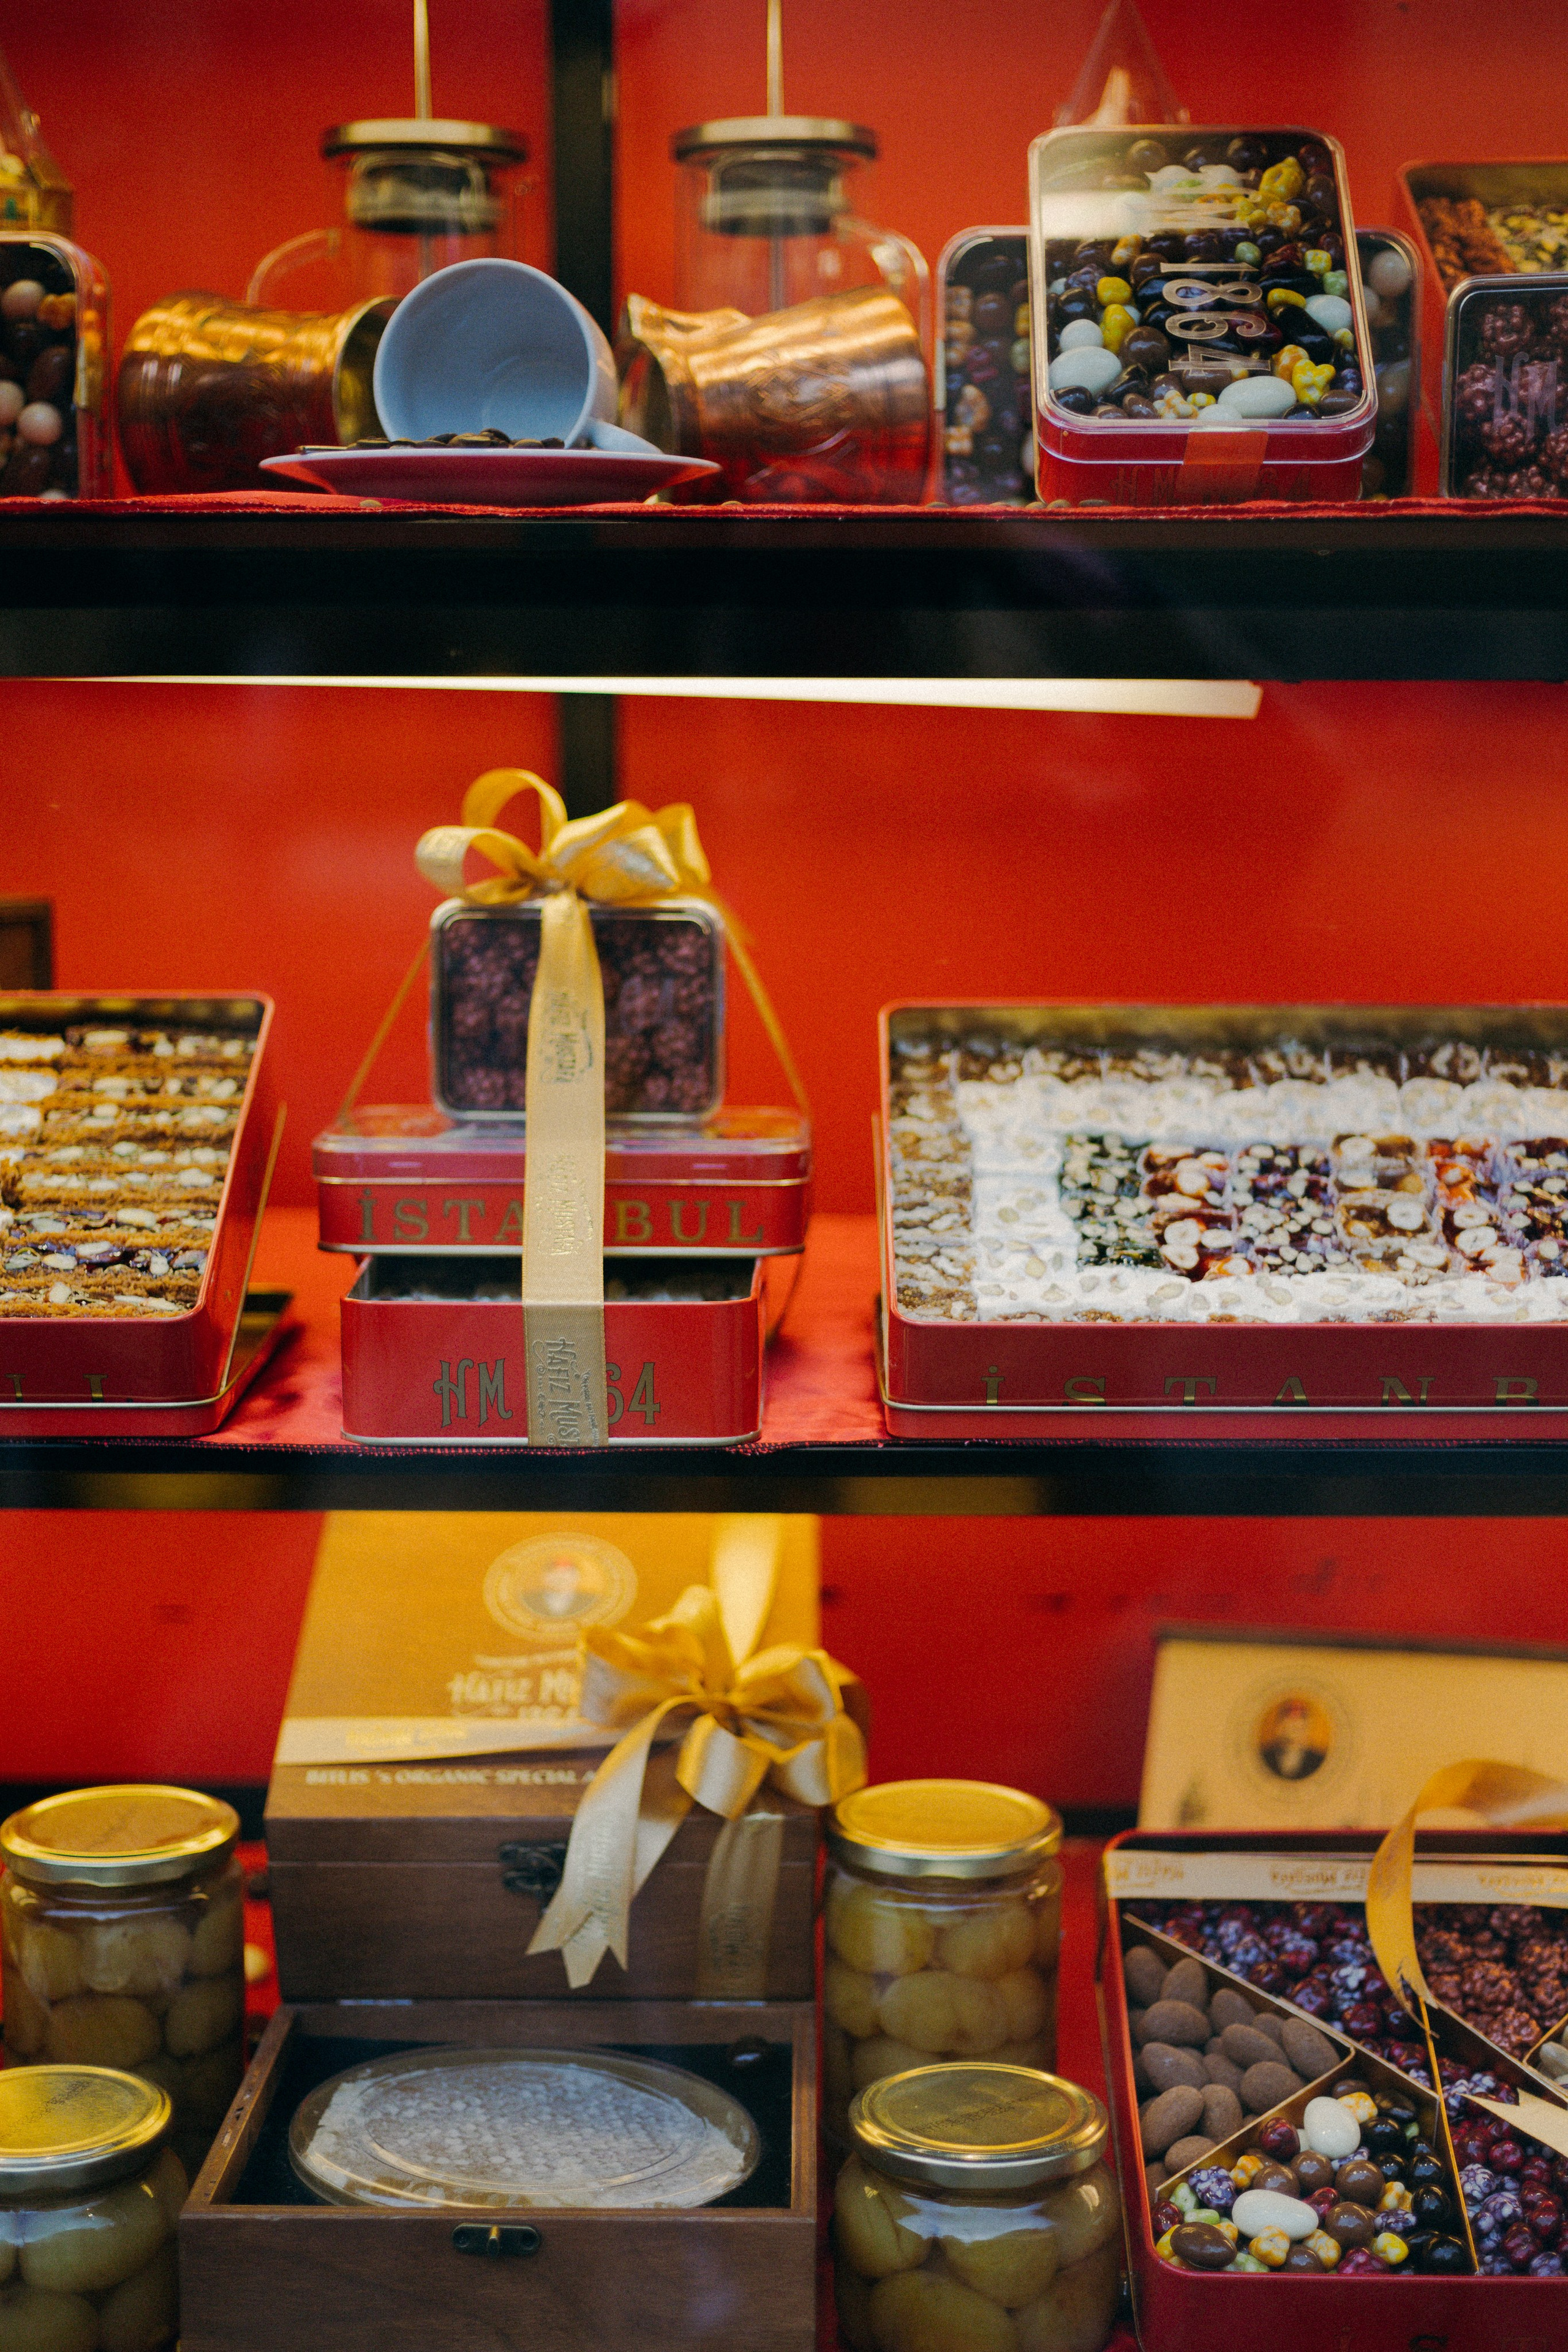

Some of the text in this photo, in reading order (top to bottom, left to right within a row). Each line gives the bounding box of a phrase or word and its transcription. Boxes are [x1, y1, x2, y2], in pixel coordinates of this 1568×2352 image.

[1160, 263, 1270, 376] 1864
[1484, 352, 1564, 445] HM
[358, 1188, 764, 1243] İSTABUL
[548, 1199, 578, 1256] MUSTAFA
[433, 1358, 513, 1428] HM
[606, 1362, 661, 1425] 64
[541, 1337, 582, 1447] HAFIZ MUST
[394, 1769, 488, 1785] ORGANIC
[496, 1769, 577, 1785] SPECIAL
